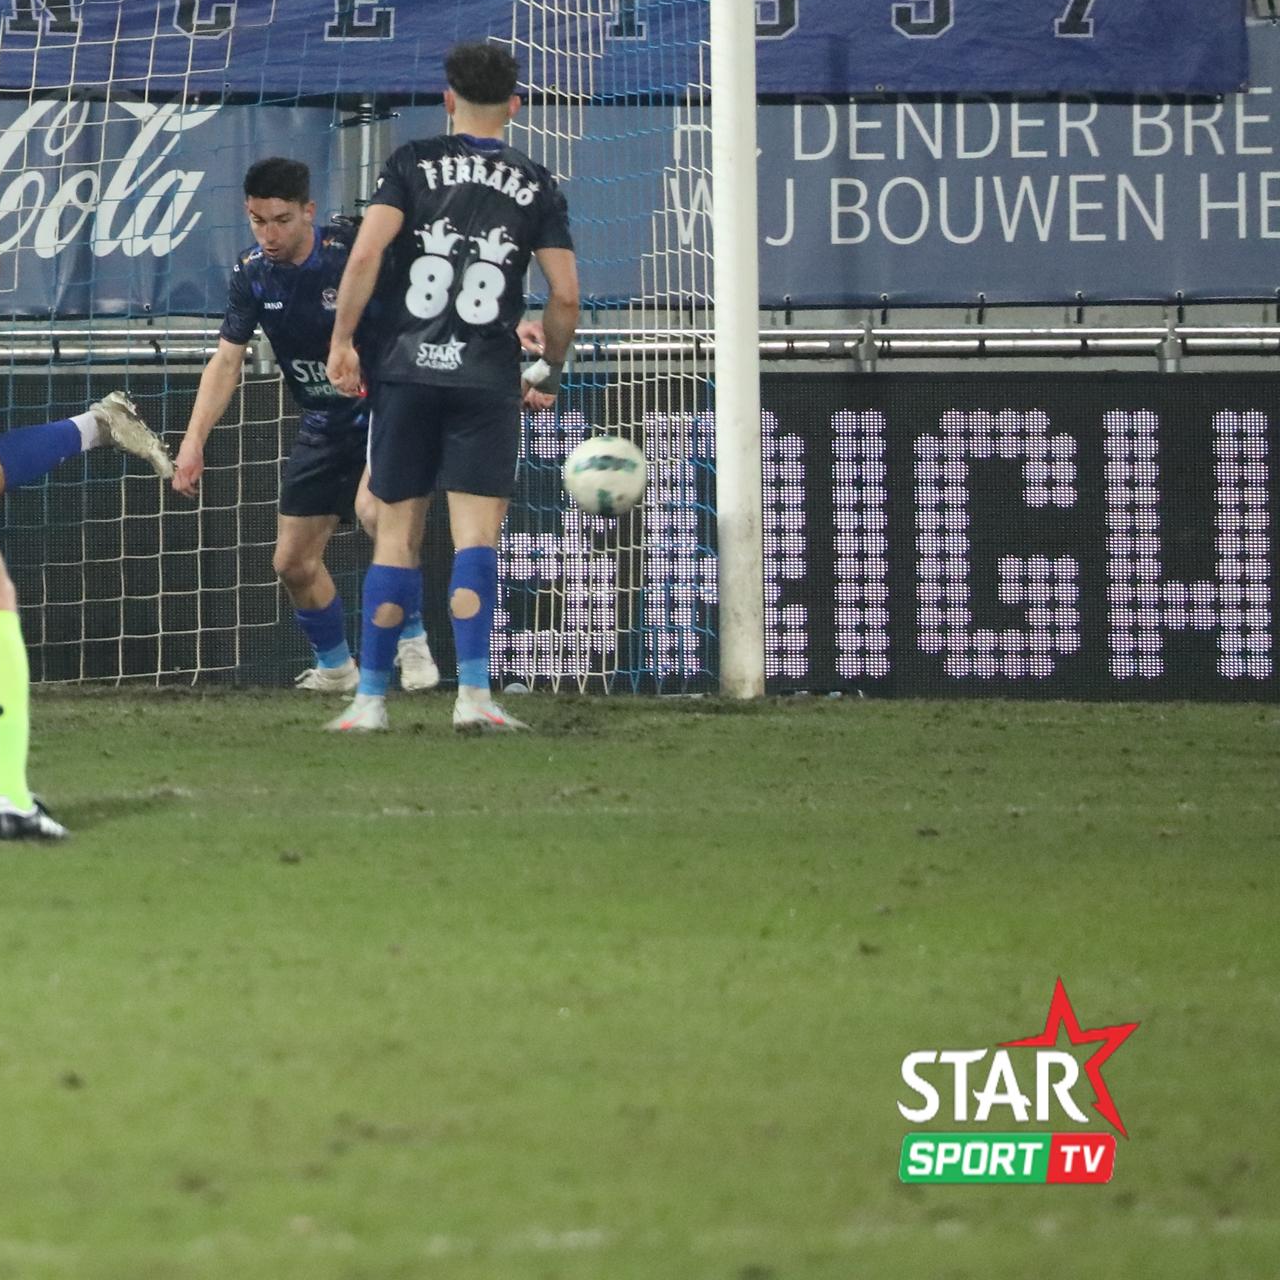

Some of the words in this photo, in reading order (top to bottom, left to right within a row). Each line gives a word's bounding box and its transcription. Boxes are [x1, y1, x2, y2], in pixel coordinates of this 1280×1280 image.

[793, 96, 1100, 161] DENDER
[422, 160, 536, 207] FERRARO
[669, 176, 795, 247] WJ
[830, 173, 1165, 247] BOUWEN
[405, 254, 506, 325] 88
[416, 358, 459, 370] CASINO
[417, 340, 462, 363] STAR
